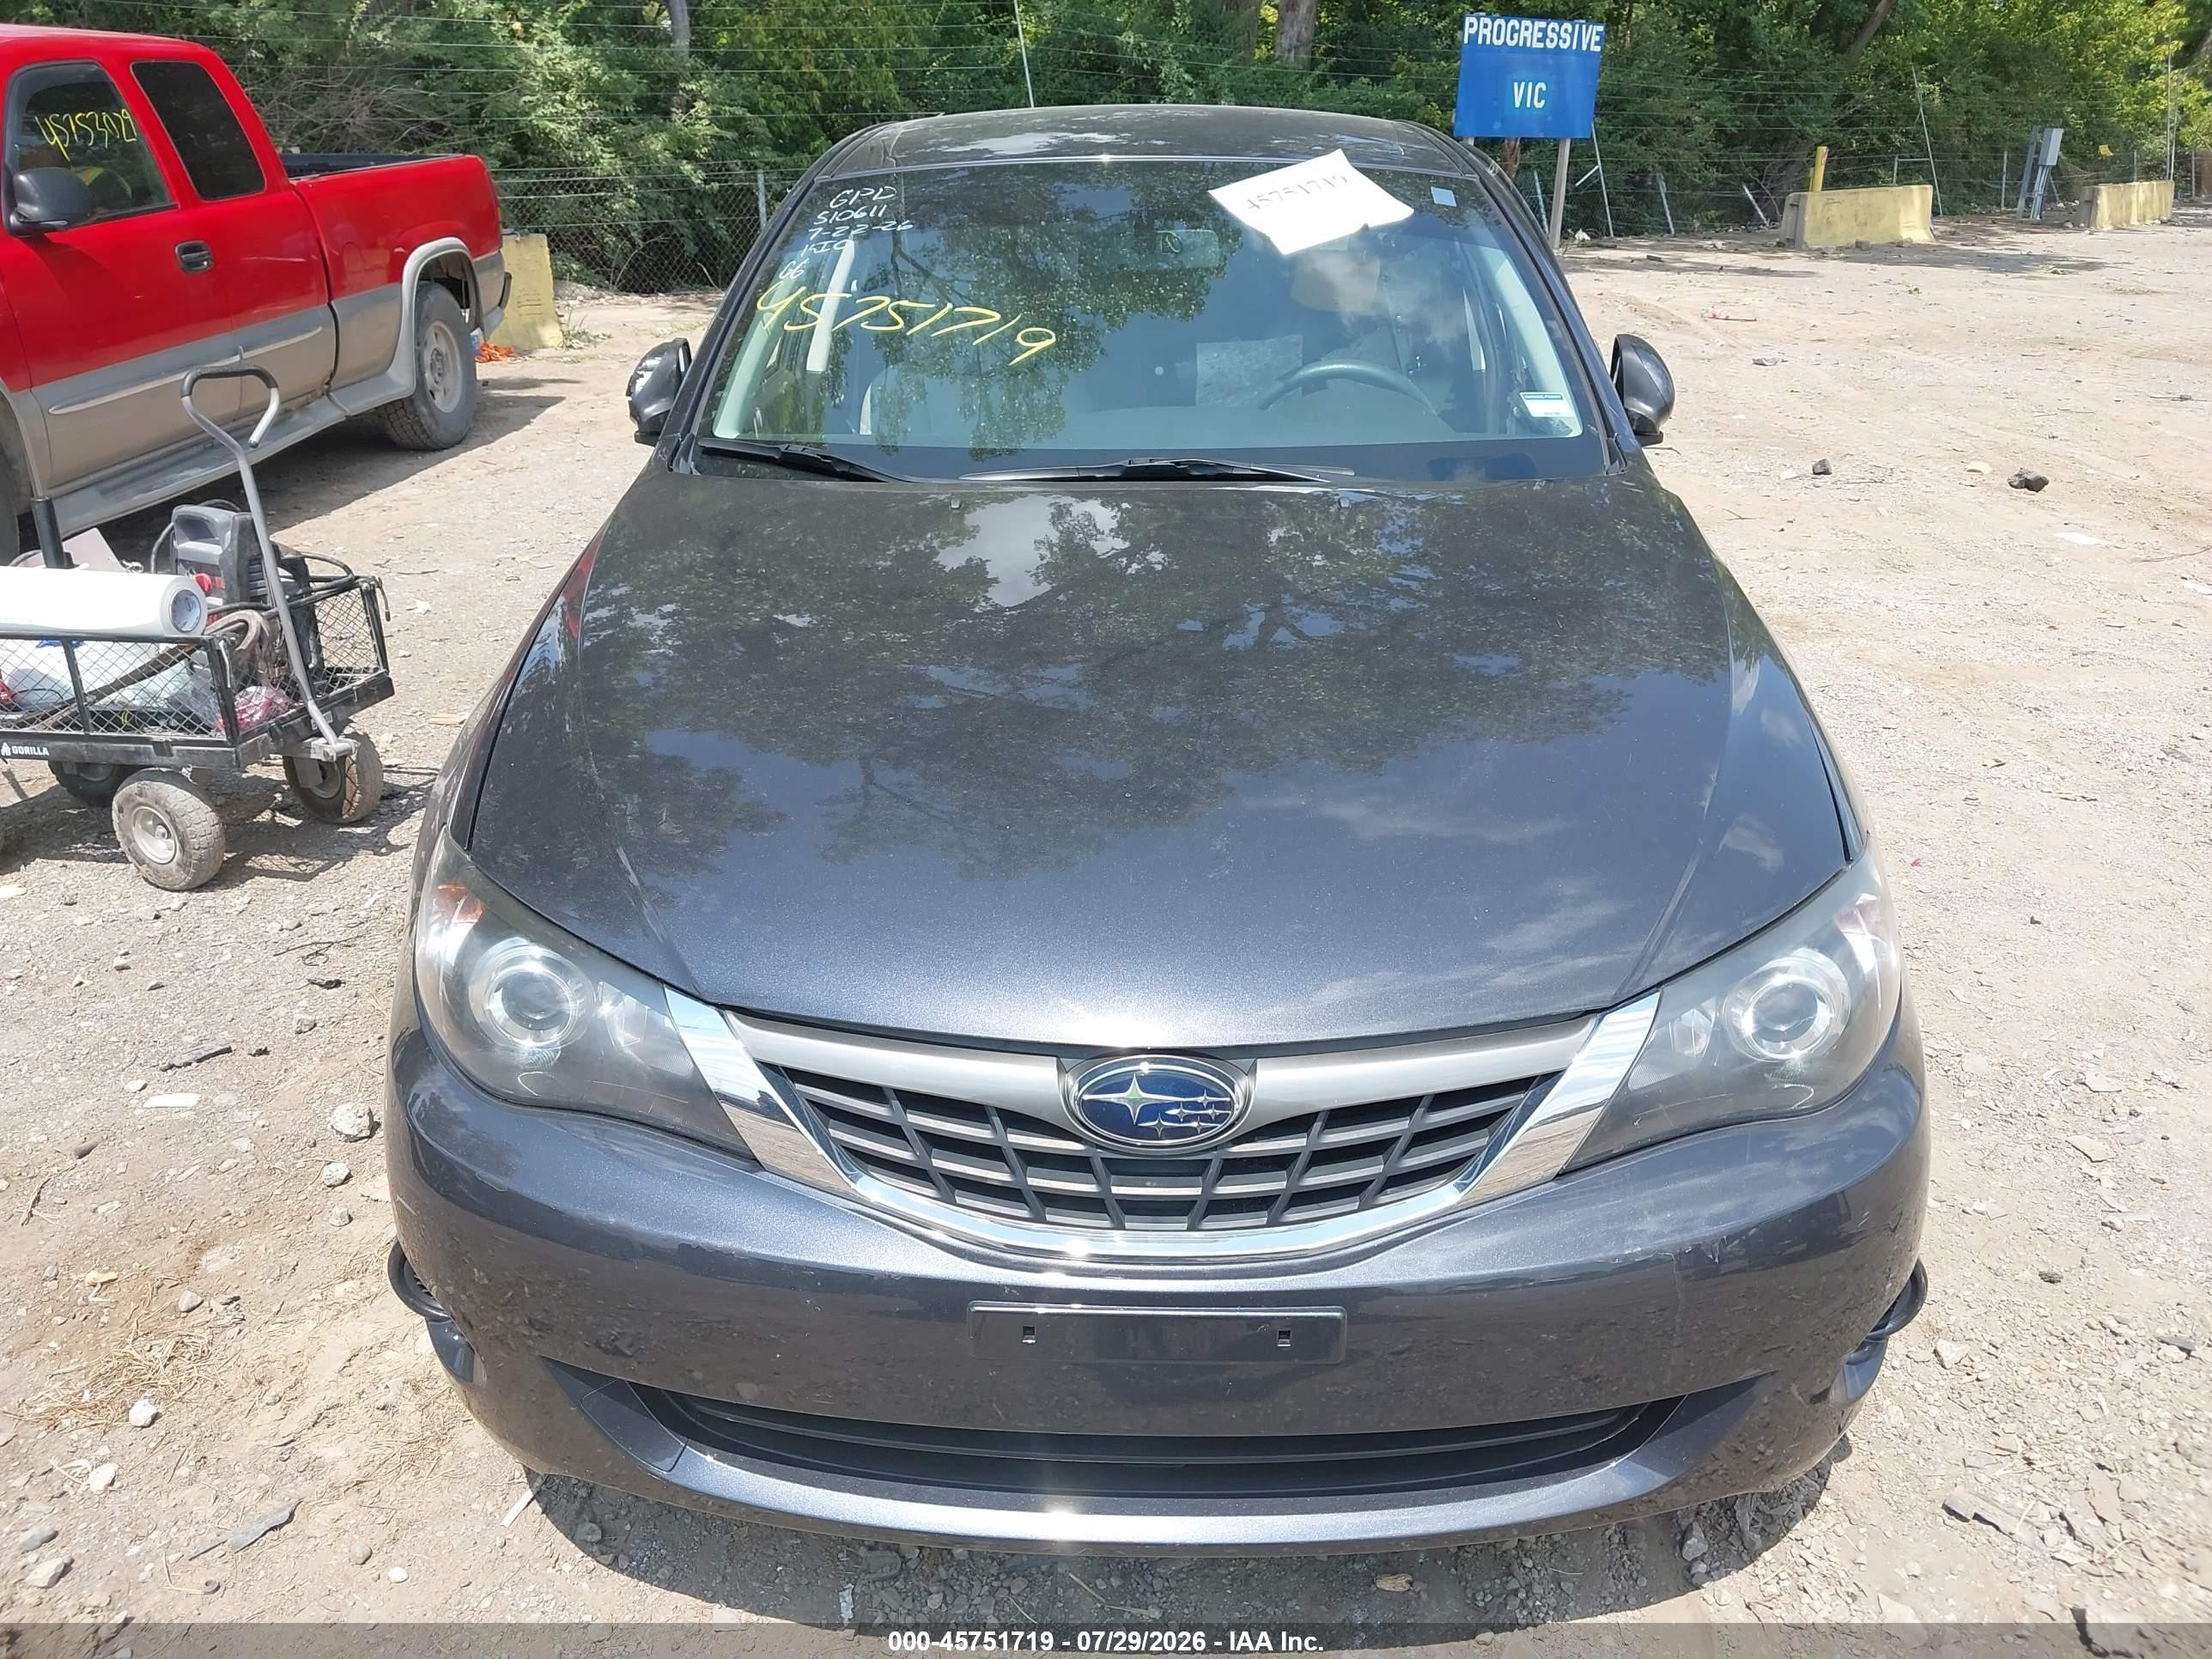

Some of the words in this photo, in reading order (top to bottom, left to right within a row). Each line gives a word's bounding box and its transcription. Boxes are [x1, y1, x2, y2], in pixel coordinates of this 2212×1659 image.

[1463, 16, 1605, 52] PROGRESSIVE
[1513, 81, 1547, 109] VIC
[830, 185, 898, 209] GPD
[757, 280, 1057, 367] 45751719
[11, 745, 50, 756] GORILLA
